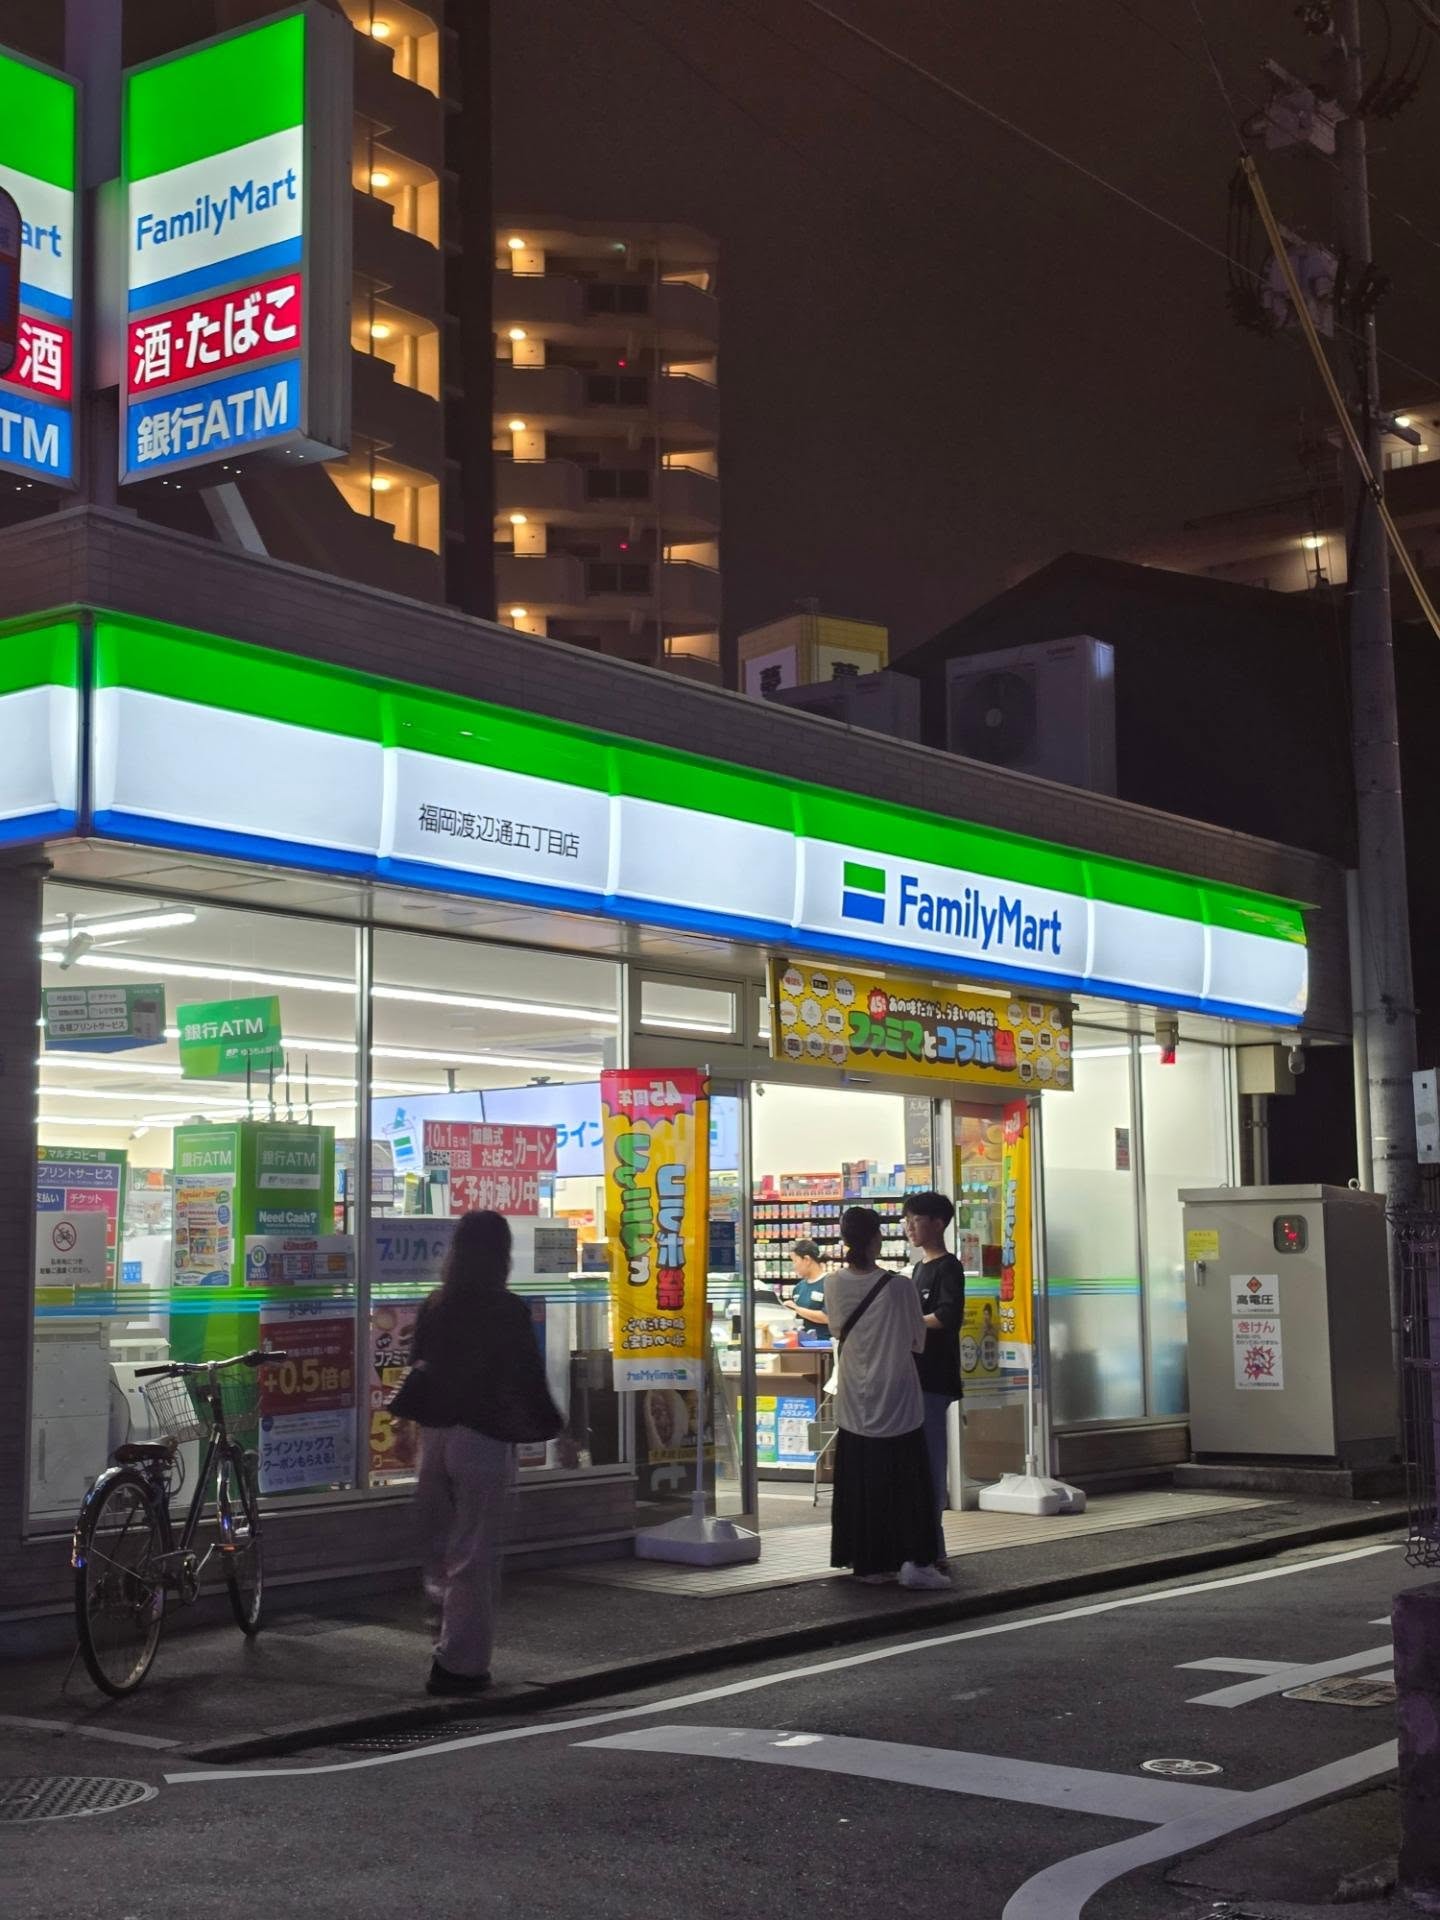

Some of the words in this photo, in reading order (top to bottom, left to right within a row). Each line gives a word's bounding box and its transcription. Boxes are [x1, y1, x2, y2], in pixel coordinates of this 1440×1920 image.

[136, 168, 297, 252] FamilyMart
[133, 284, 297, 386] 酒・たばこ
[19, 320, 63, 391] 酒
[136, 379, 289, 464] 銀行ATM
[418, 802, 580, 858] 福岡渡辺通五丁目店
[898, 874, 1062, 956] FamilyMart
[184, 1016, 264, 1041] 銀行ATM
[182, 1149, 232, 1168] 銀行ATM
[261, 1150, 317, 1167] 銀行ATM
[481, 1147, 514, 1167] たばこ
[514, 1129, 556, 1166] カートン
[69, 1193, 103, 1204] チケット
[451, 1174, 538, 1211] ご予約承り中
[259, 1210, 285, 1223] Need
[286, 1211, 318, 1224] Cash?
[1236, 1294, 1274, 1305] 高電圧
[1237, 1320, 1275, 1334] きけん
